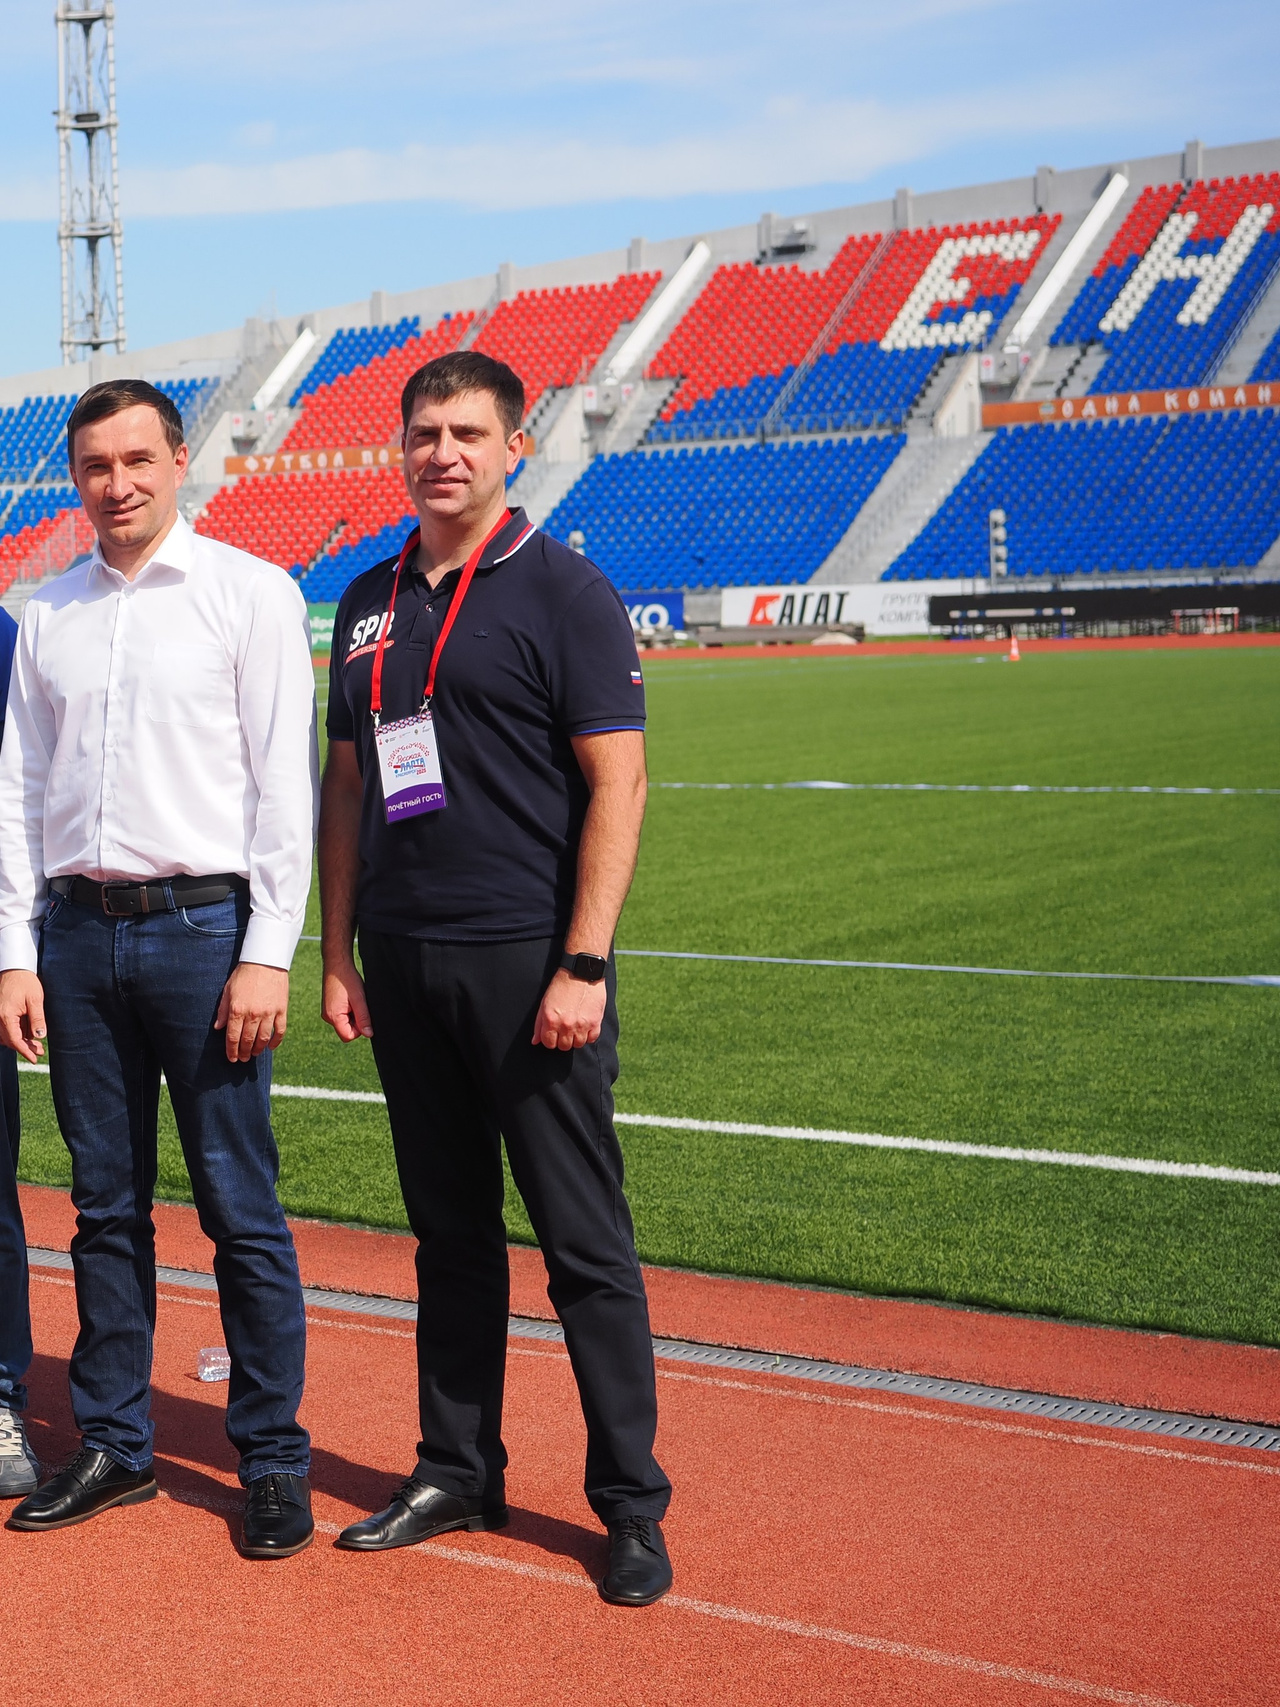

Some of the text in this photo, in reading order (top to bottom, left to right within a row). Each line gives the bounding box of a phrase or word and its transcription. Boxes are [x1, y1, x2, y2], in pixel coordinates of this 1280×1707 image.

[1061, 394, 1140, 418] ОДНА
[244, 450, 345, 472] ФУТБОЛ
[778, 591, 850, 625] АГАТ
[349, 611, 396, 652] SPB
[400, 758, 426, 772] ЛАПТА
[387, 792, 442, 813] ПОЧЁТНЫЙ ГОСТЬ
